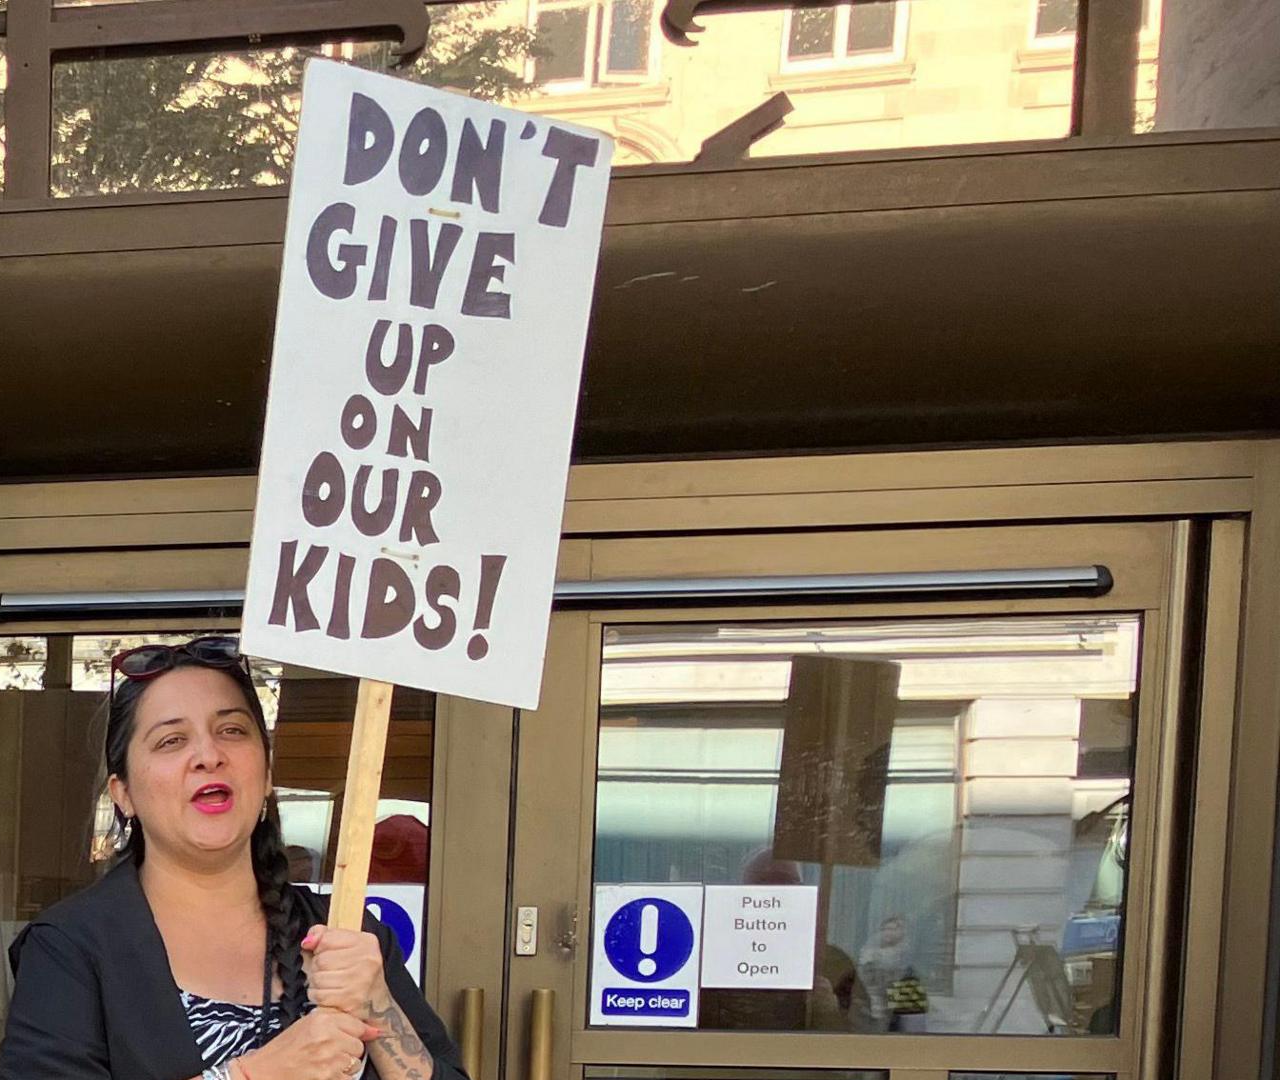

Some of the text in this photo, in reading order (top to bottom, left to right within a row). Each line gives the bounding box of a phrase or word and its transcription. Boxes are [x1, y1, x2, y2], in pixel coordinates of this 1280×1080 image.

[344, 92, 599, 228] DON'T
[307, 203, 515, 318] GIVE
[366, 320, 455, 396] UP
[341, 394, 432, 462] ON
[302, 451, 442, 546] OUR
[268, 540, 507, 661] KIDS!
[734, 918, 787, 931] Button
[742, 896, 781, 909] Push
[737, 962, 779, 977] Open
[752, 941, 767, 953] to
[606, 994, 686, 1011] Keep clear
